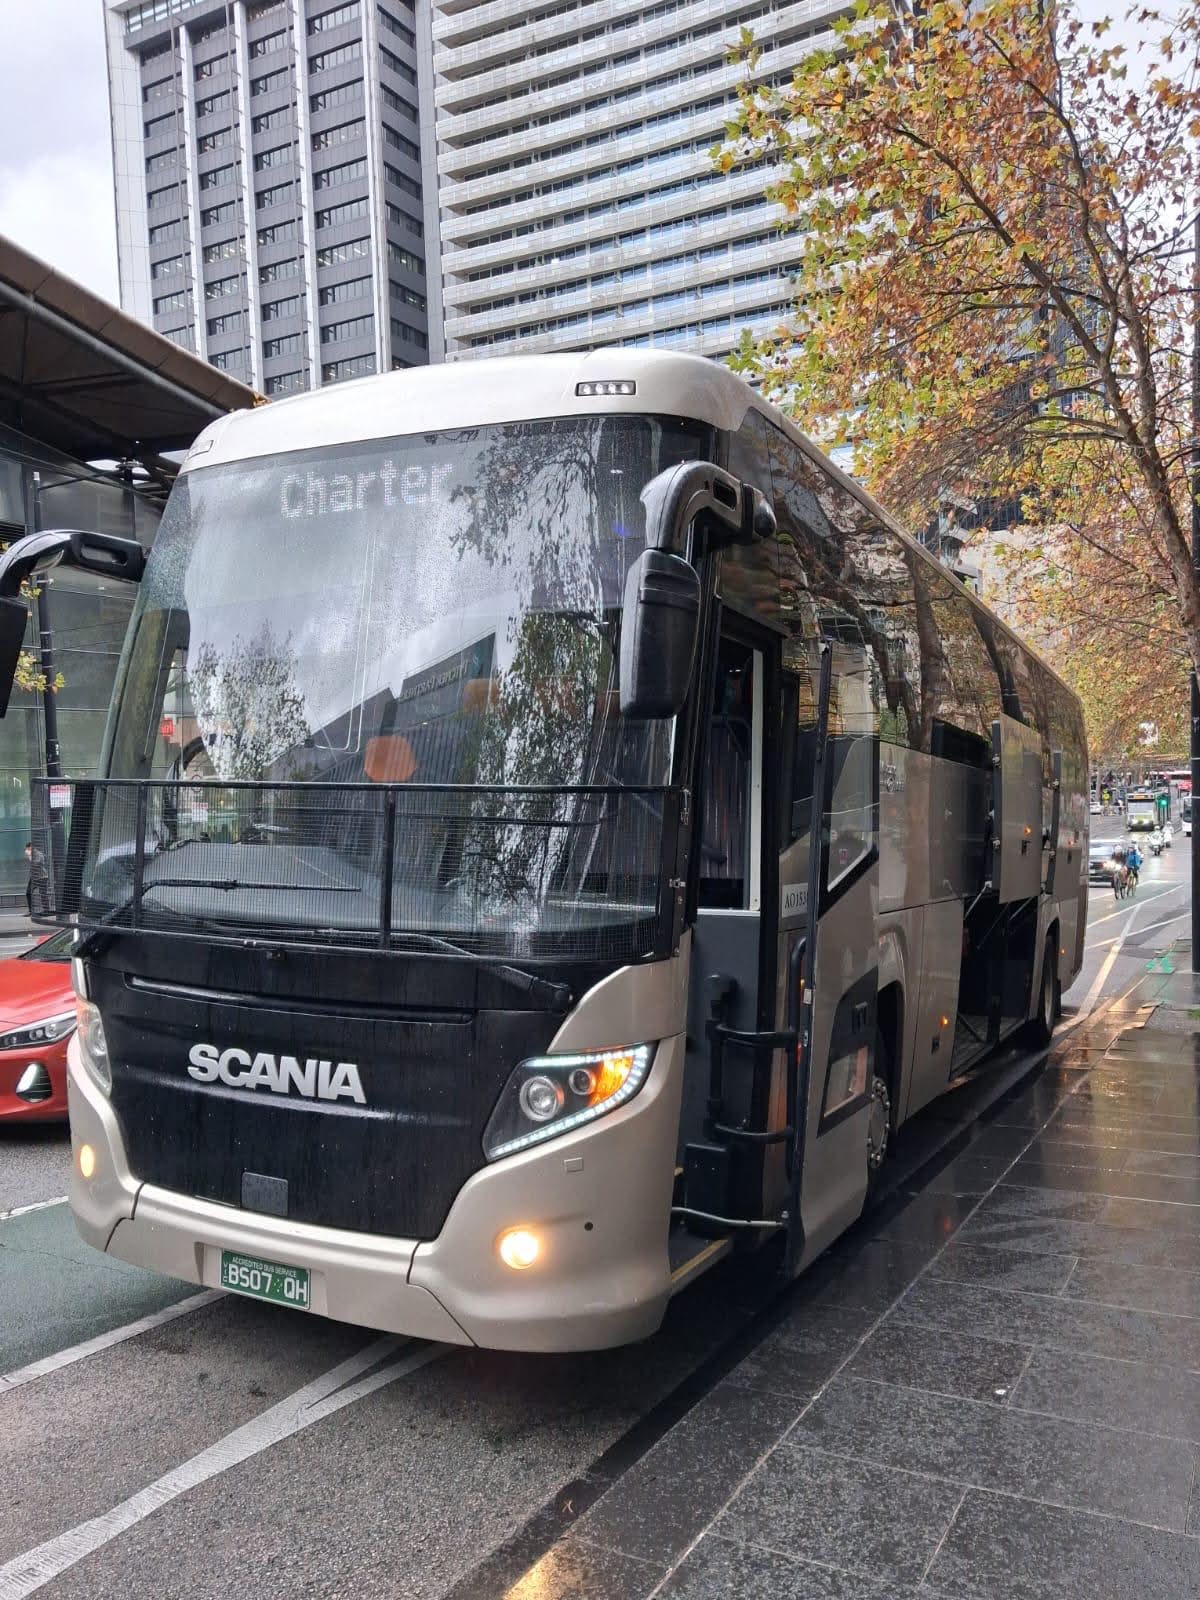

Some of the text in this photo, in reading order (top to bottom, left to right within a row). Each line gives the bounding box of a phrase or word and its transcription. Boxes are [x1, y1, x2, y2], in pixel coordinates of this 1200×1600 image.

[280, 458, 454, 519] Charter
[785, 891, 808, 909] AO153
[187, 1043, 367, 1104] SCANIA
[232, 1257, 263, 1270] ACCREDITED
[263, 1264, 274, 1273] BUS
[284, 1277, 307, 1302] QH
